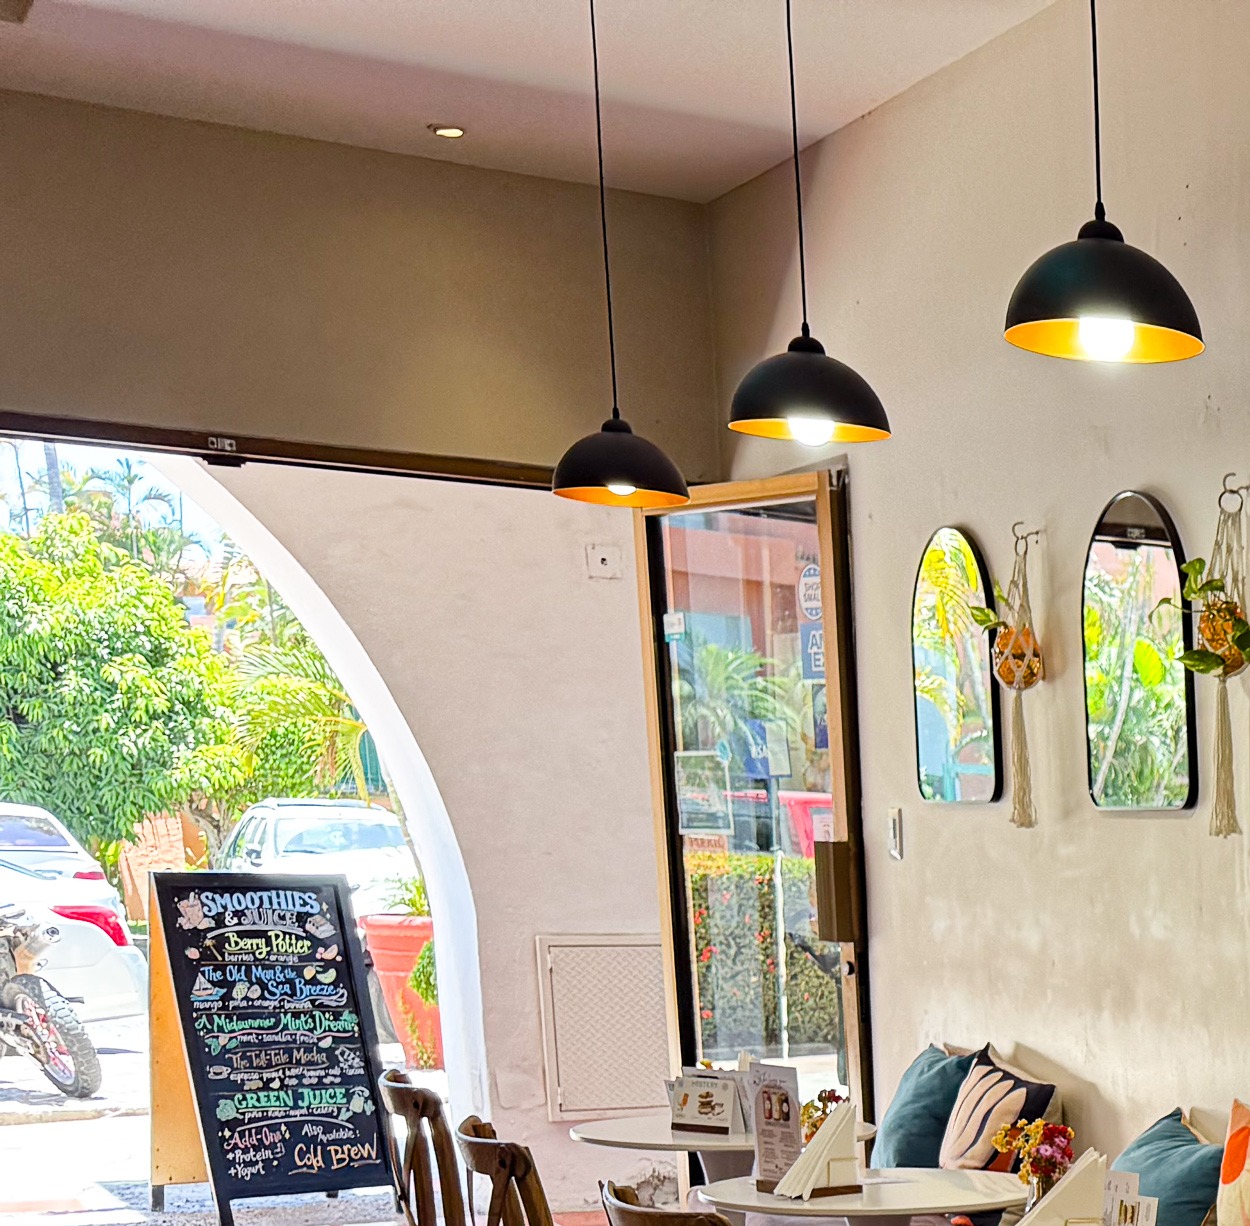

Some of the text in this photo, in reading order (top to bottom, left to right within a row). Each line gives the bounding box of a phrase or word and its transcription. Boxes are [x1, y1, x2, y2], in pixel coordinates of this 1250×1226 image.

[200, 889, 320, 916] SMOOTHIES
[225, 909, 298, 928] & JUICE
[224, 930, 312, 959] Berry Potter
[224, 952, 298, 965] berries orange
[200, 967, 223, 980] The
[226, 966, 246, 981] Old
[252, 965, 275, 983] Man
[275, 966, 284, 981] &
[264, 978, 336, 1000] Sea Breeze
[193, 1001, 222, 1012] mango
[195, 1015, 212, 1029] A
[213, 1015, 276, 1032] Midsummer
[225, 1049, 328, 1068] The Tell-Tale Mocha
[234, 1088, 347, 1109] GREEN JUICE
[224, 1128, 283, 1150] Add-Ons
[301, 1123, 323, 1138] Also
[294, 1143, 326, 1170] Cold
